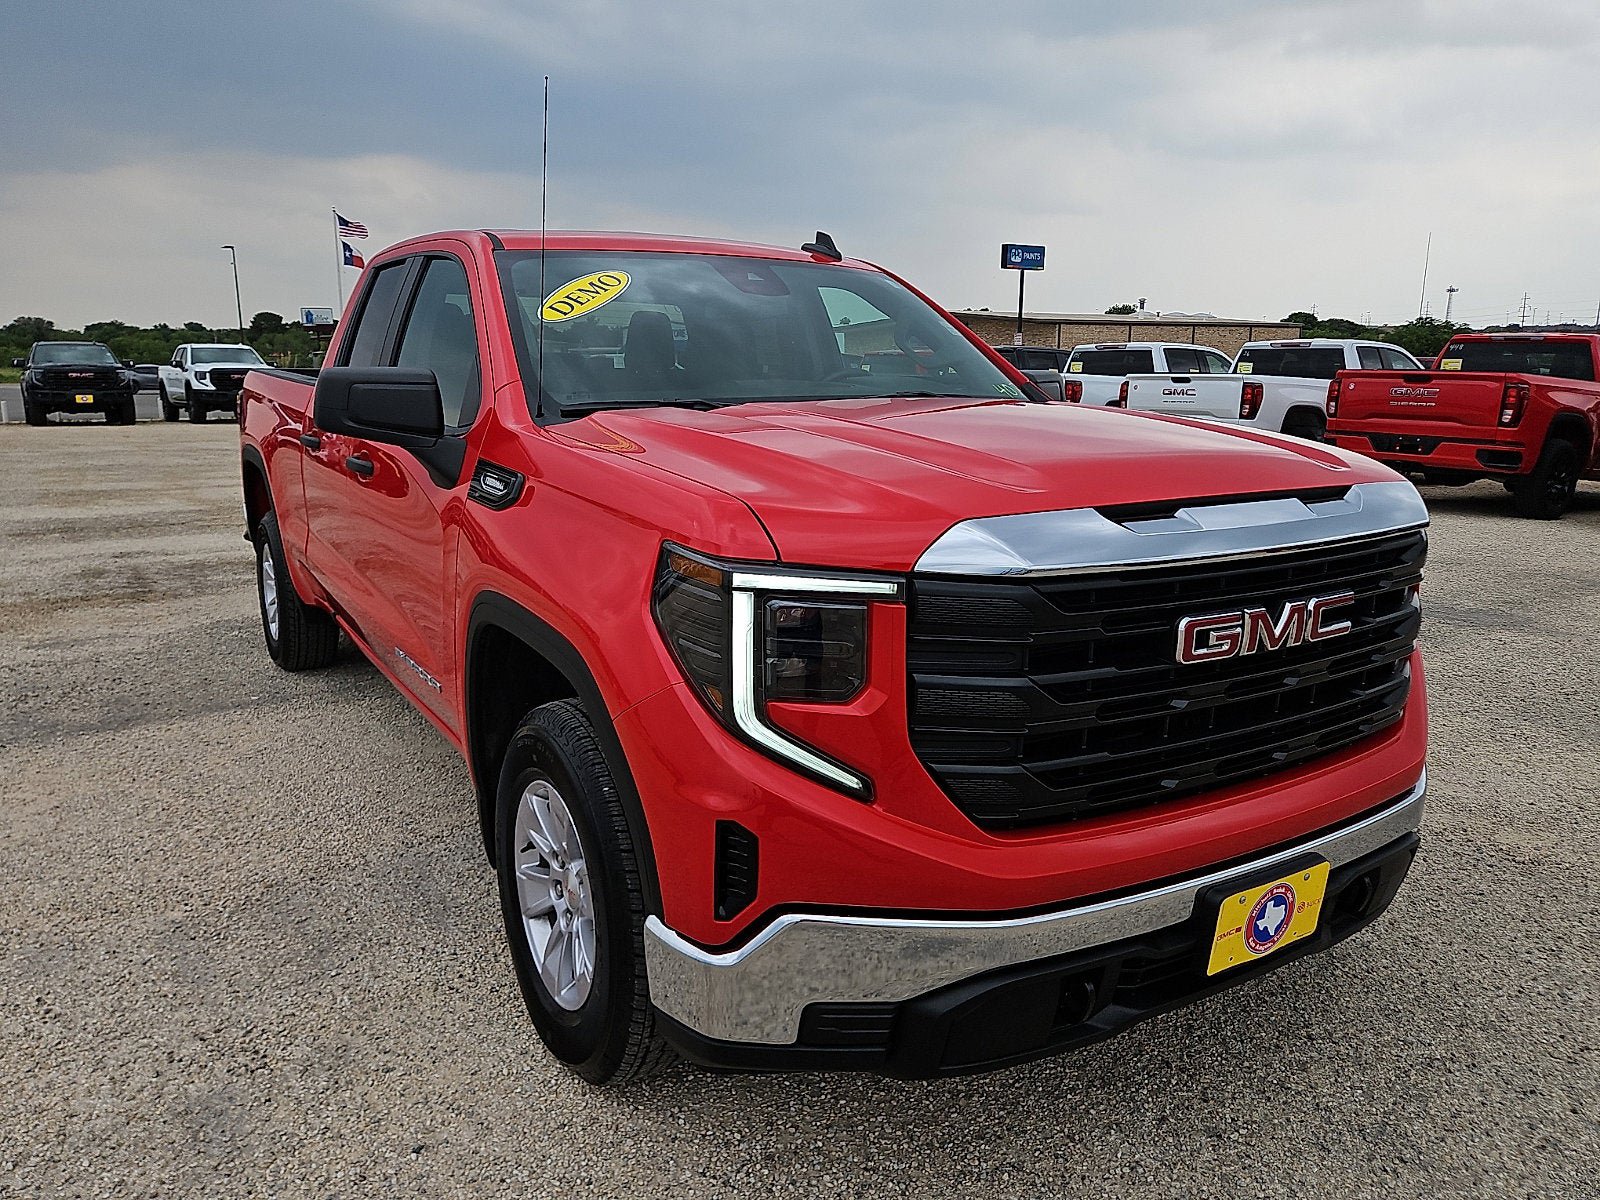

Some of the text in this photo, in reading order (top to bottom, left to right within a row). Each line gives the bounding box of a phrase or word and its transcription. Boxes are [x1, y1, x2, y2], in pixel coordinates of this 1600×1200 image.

[1023, 252, 1041, 261] PAINTS
[546, 274, 622, 317] DEMO
[1162, 388, 1197, 396] GMC
[1389, 387, 1440, 398] GMC
[1176, 591, 1355, 664] GMC
